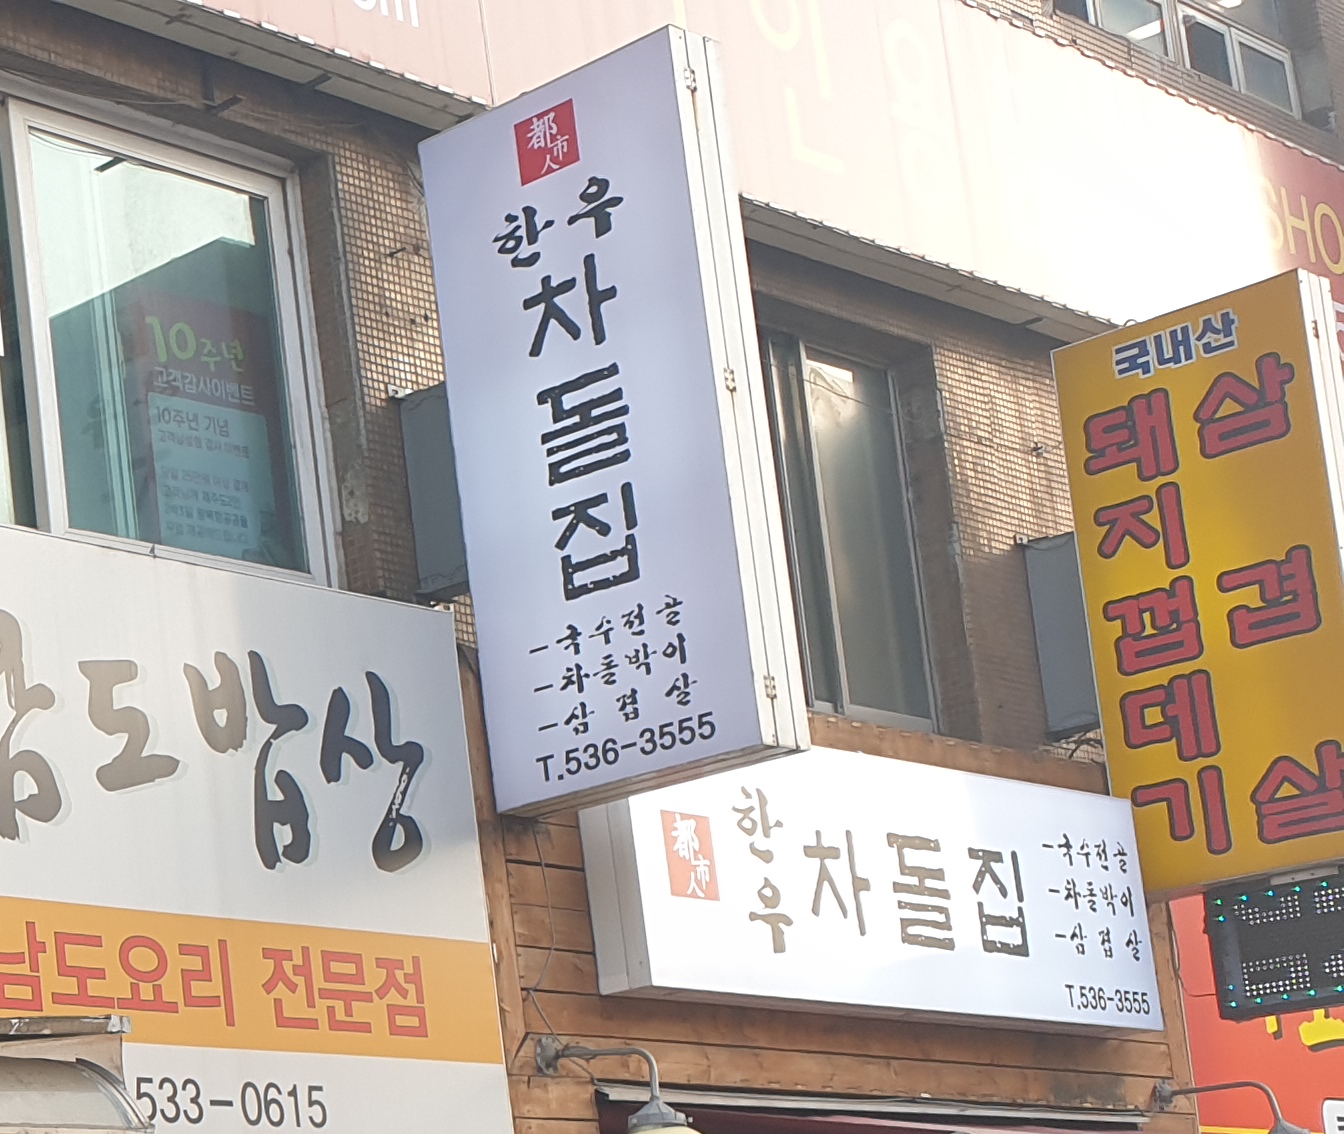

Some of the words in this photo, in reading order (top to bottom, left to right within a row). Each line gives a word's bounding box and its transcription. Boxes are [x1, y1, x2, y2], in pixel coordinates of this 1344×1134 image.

[491, 174, 625, 269] 한우
[145, 315, 247, 373] 10주년
[1113, 308, 1239, 379] 국내산
[152, 366, 256, 406] 고객감사이벤트
[155, 406, 200, 432] 10주년
[522, 252, 641, 602] 차돌집
[1083, 387, 1232, 856] 돼지껍데기
[1192, 351, 1344, 846] 삼겹살
[536, 711, 716, 783] T.536-3555
[732, 785, 794, 955] 한우
[802, 827, 1030, 958] 차돌집
[261, 945, 430, 1040] 전문점
[1065, 983, 1151, 1016] T.536-3555
[134, 1076, 329, 1131] 533-0615
